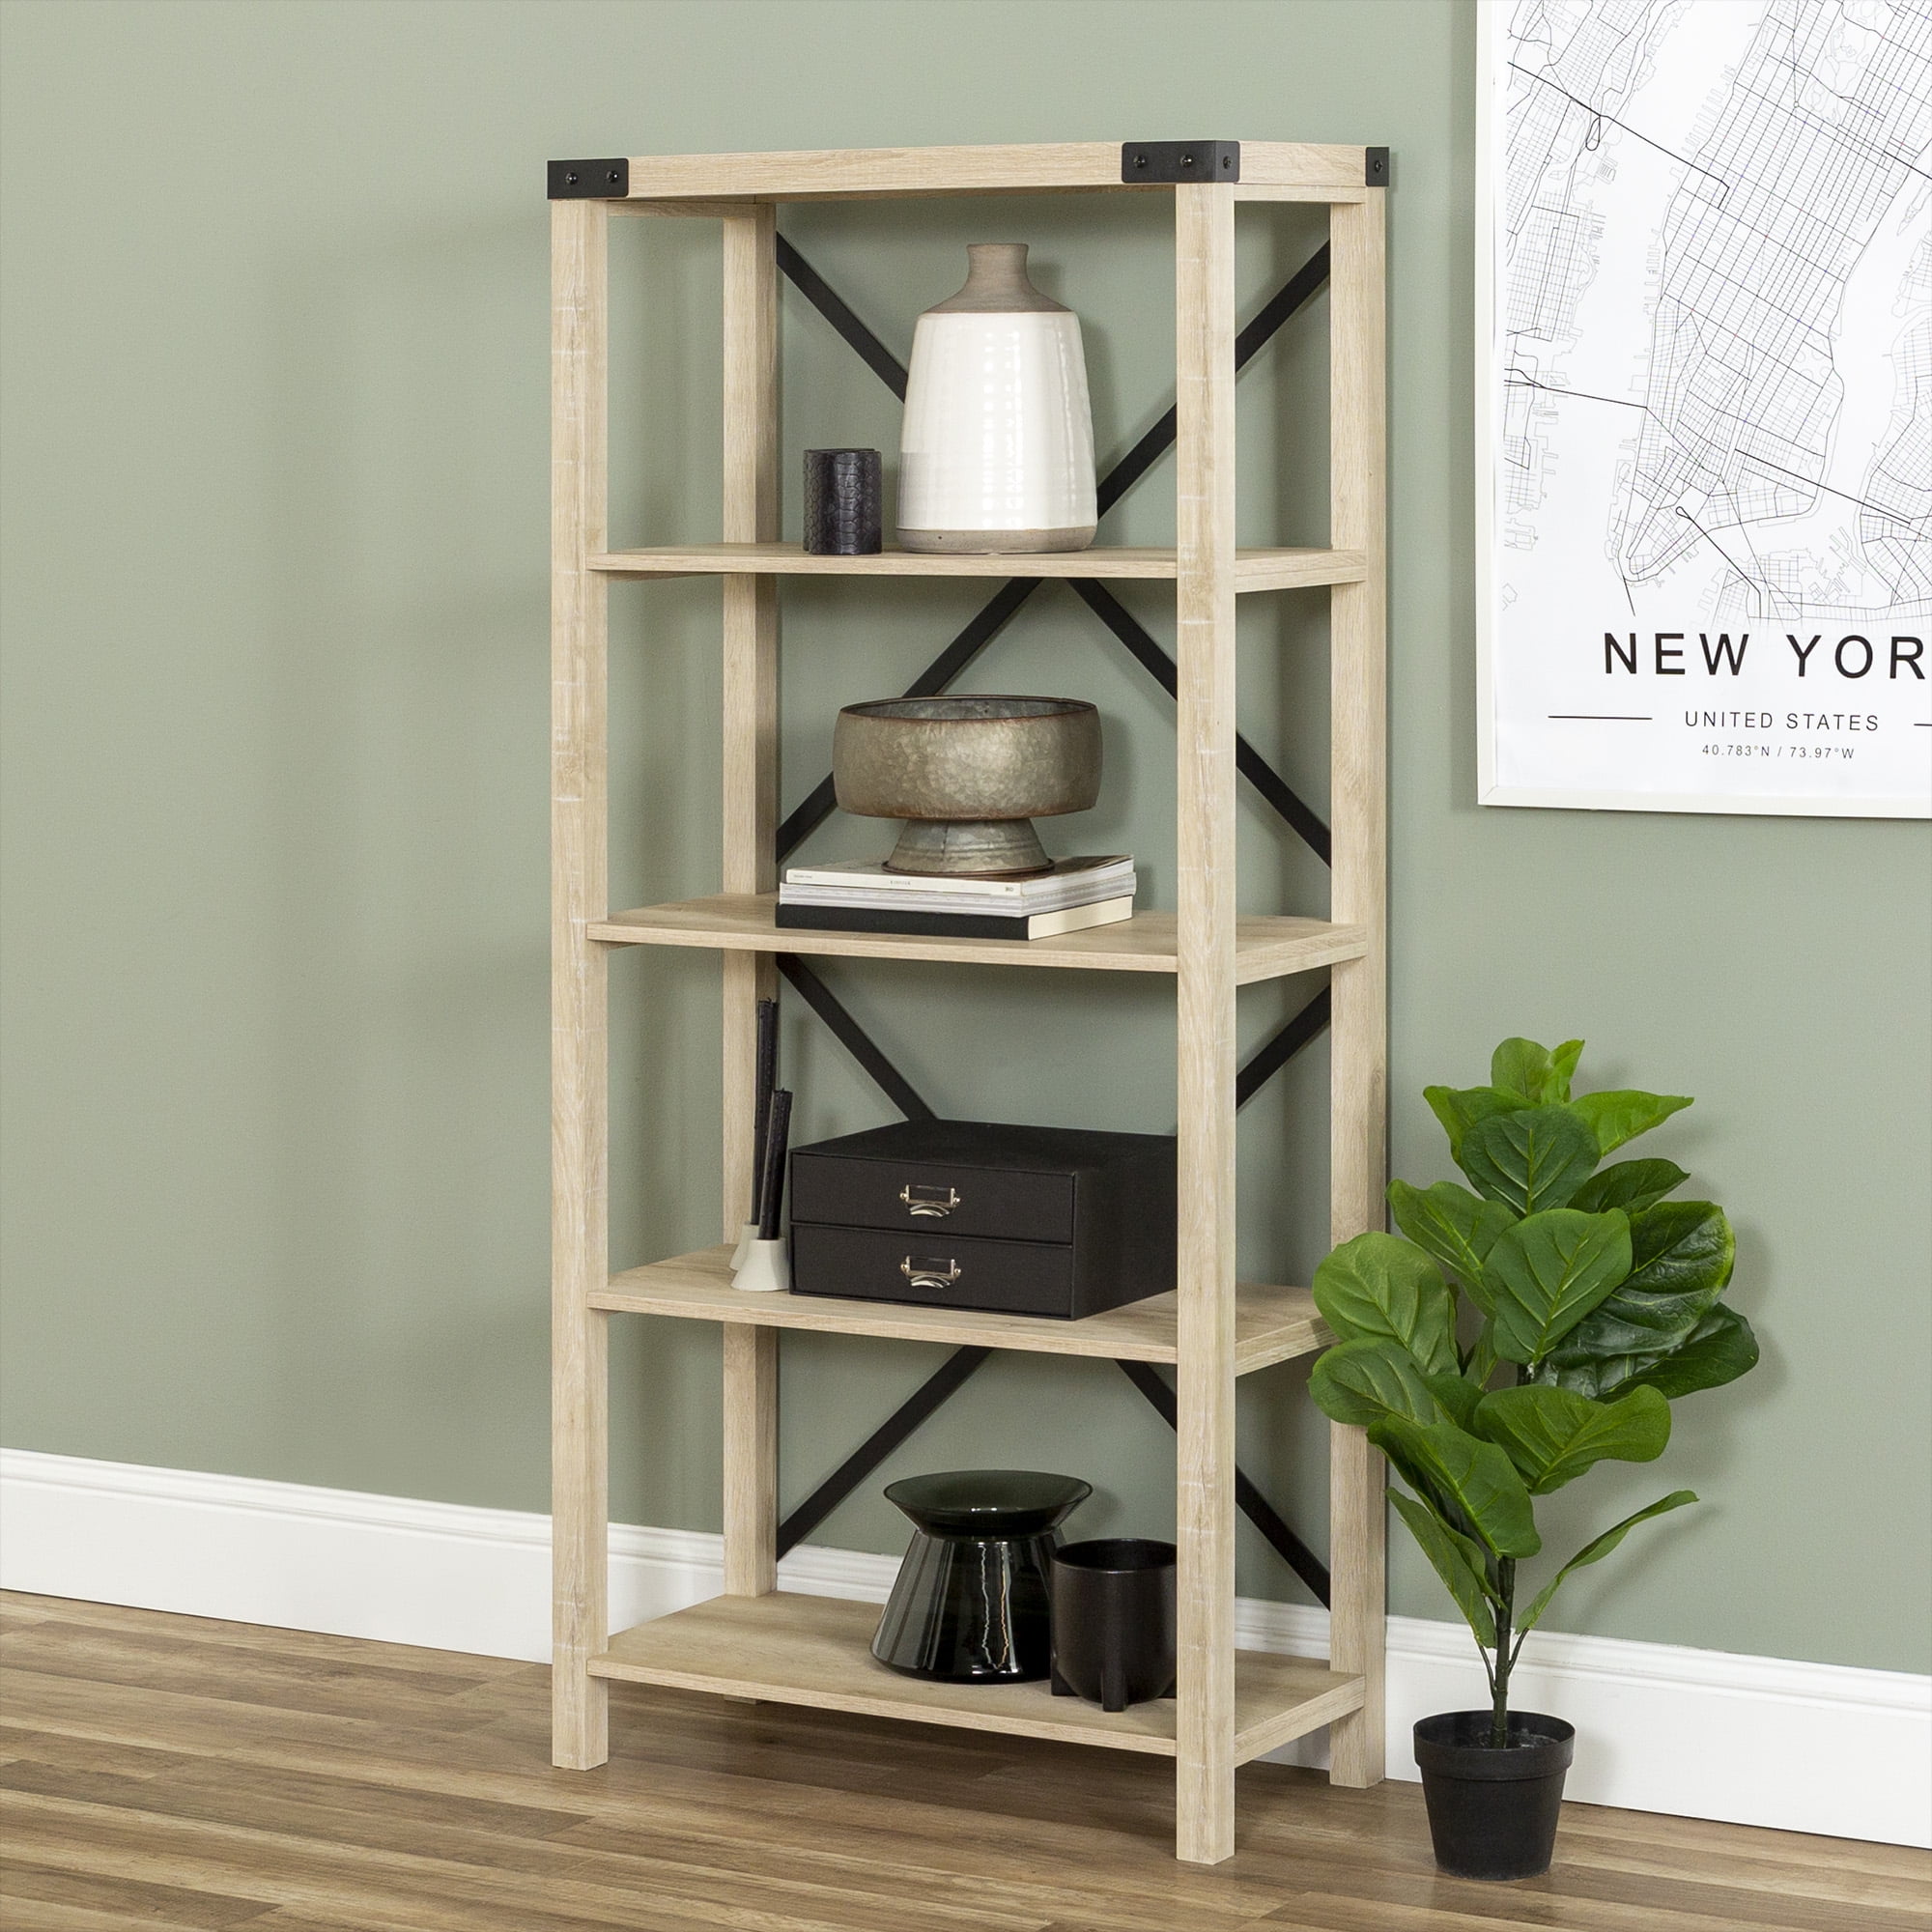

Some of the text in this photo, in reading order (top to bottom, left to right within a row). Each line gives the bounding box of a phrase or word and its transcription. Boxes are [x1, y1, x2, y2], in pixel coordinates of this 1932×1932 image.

[1604, 632, 1926, 680] NEW YOR
[1685, 710, 1879, 731] UNITED STATES
[1701, 744, 1855, 759] 40.783°N / 73.97°W
